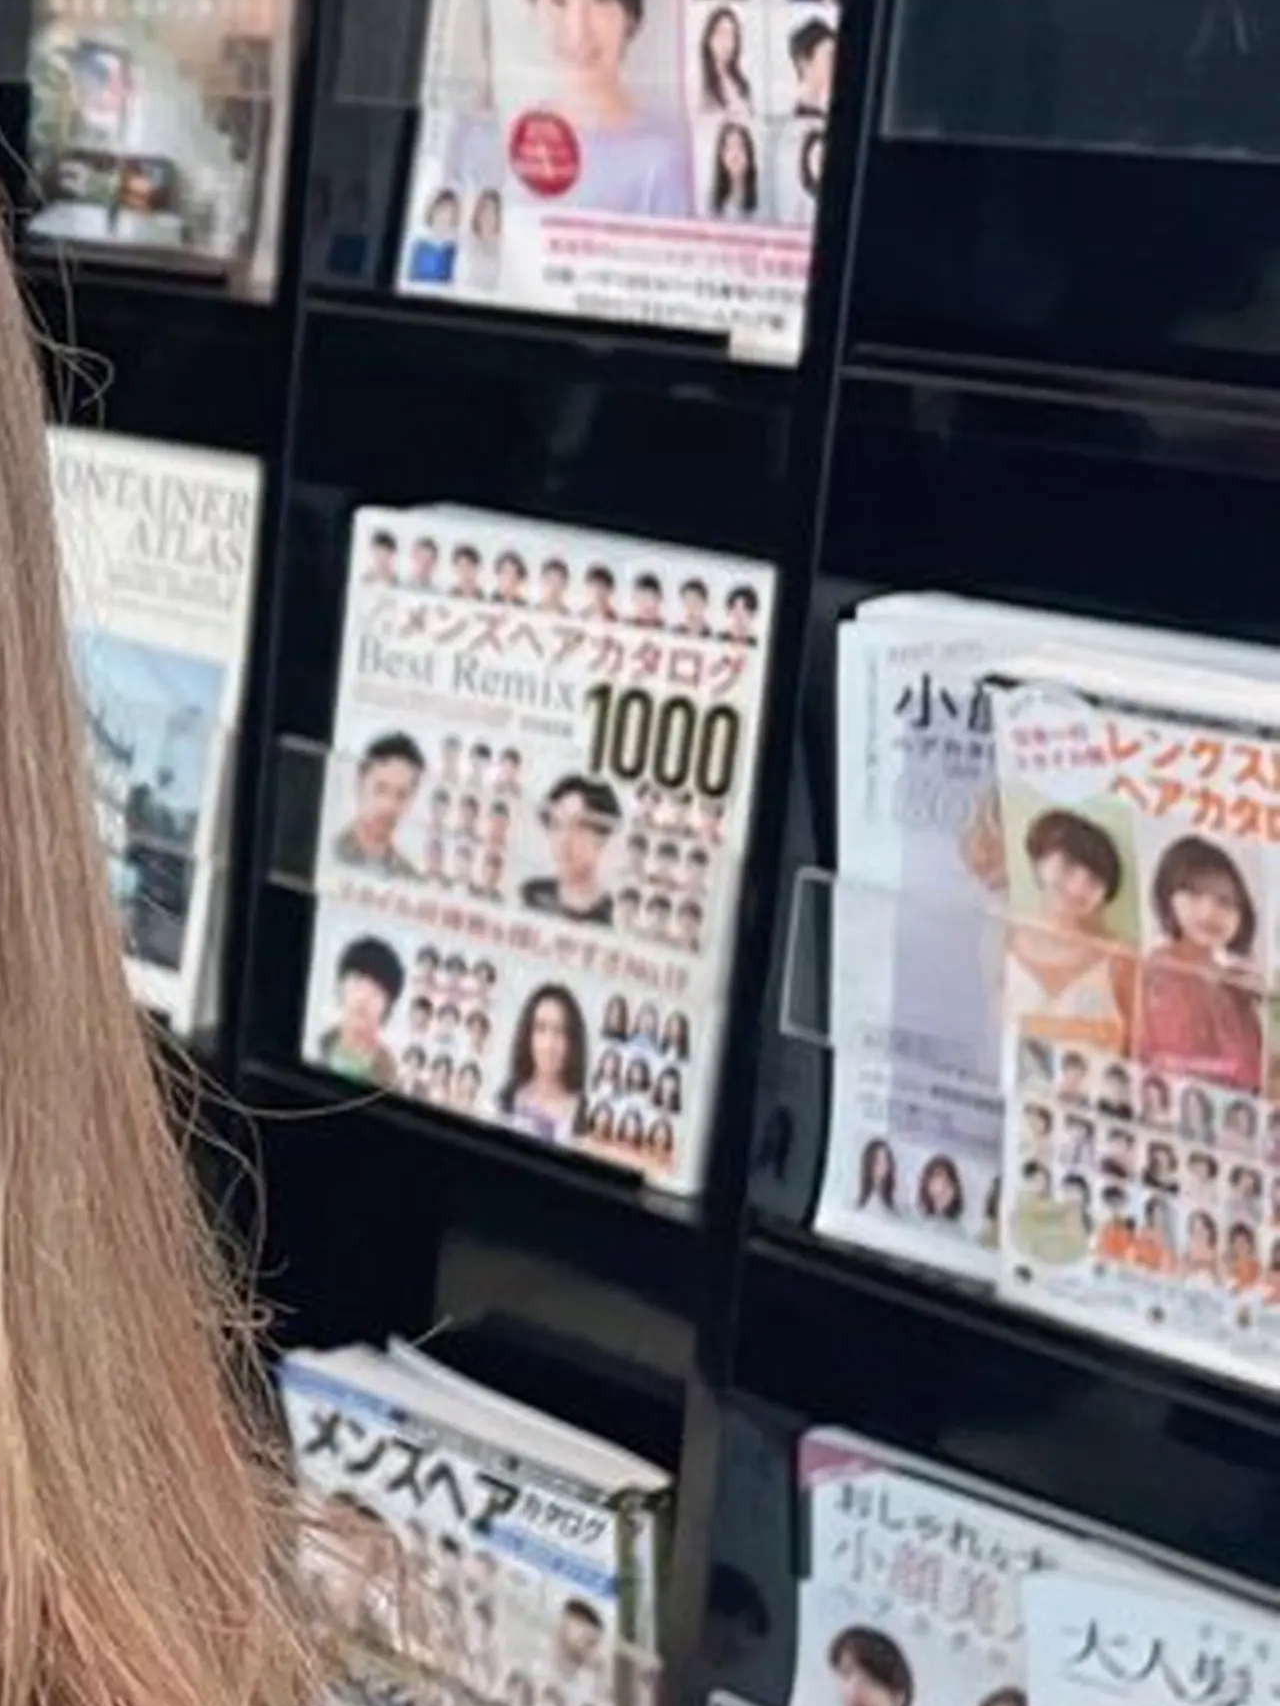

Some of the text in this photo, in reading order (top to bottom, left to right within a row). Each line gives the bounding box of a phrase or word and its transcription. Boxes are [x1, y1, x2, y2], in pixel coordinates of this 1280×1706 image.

[56, 457, 248, 531] ONTAINER
[358, 634, 435, 685] Best
[453, 652, 577, 713] Remix
[584, 681, 741, 798] 1000
[832, 1527, 1026, 1641] 小顔美
